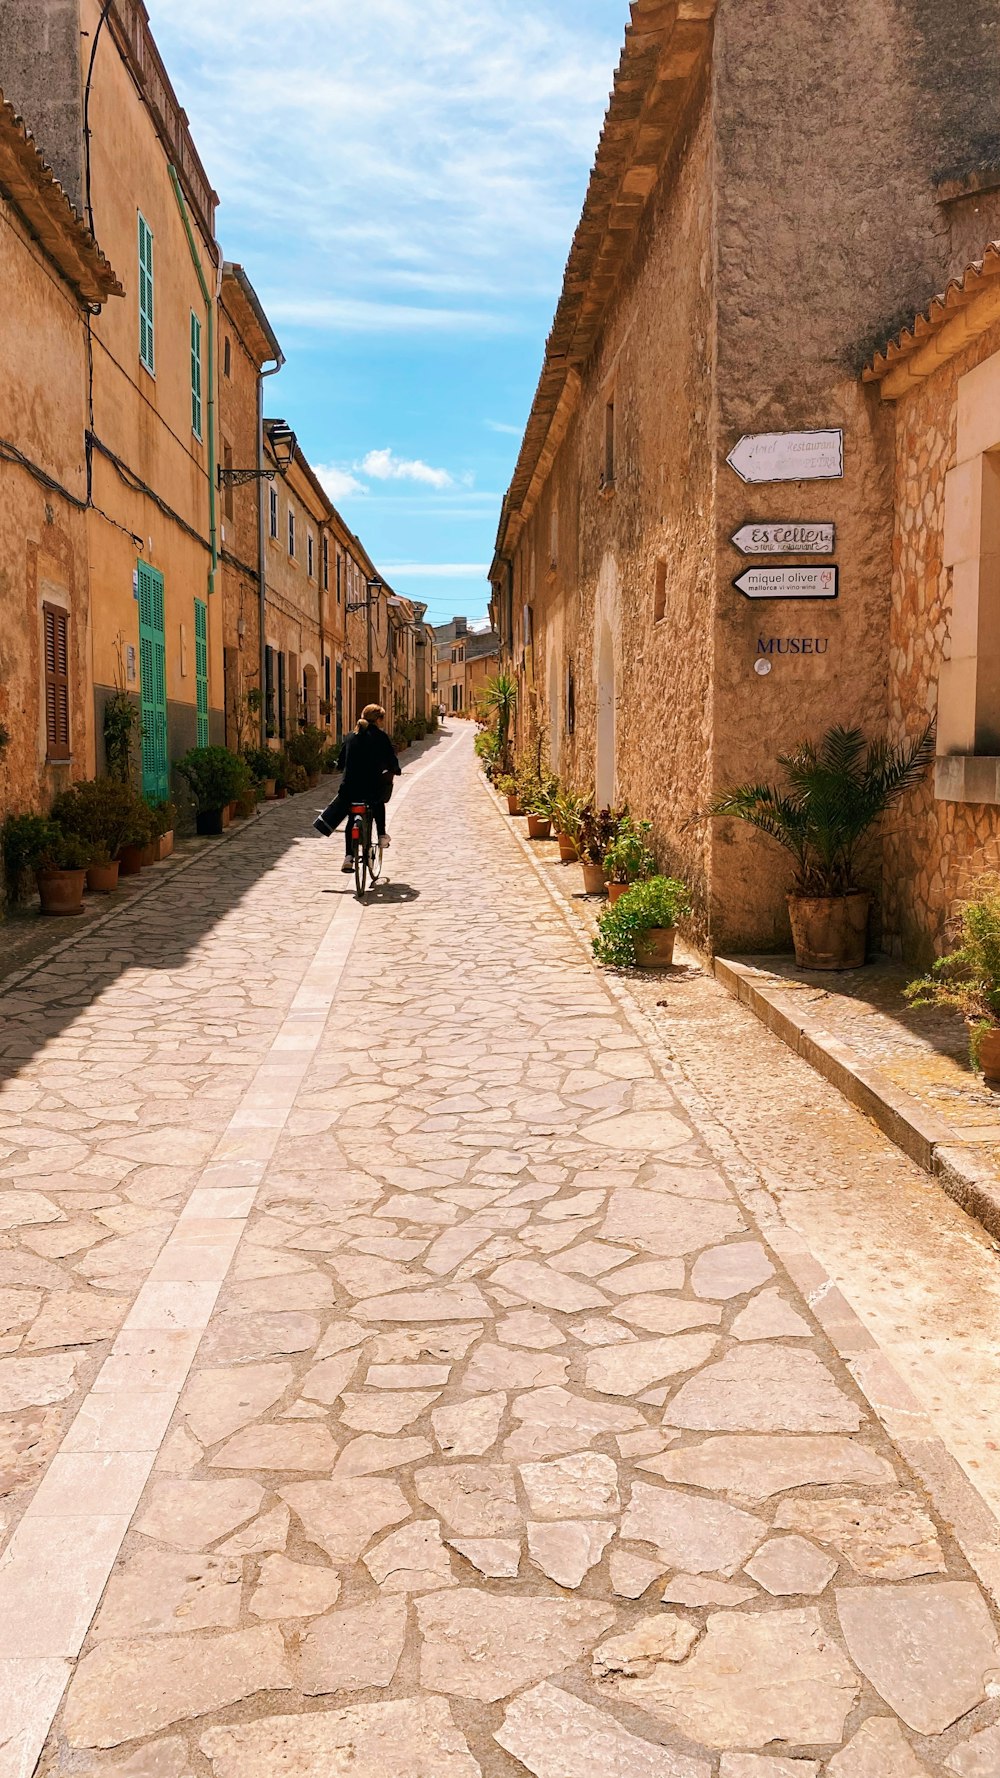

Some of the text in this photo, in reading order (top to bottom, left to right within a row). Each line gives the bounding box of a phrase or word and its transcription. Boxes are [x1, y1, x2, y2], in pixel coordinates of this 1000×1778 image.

[751, 528, 770, 543] Es
[748, 572, 818, 585] miquel oliver
[756, 638, 829, 654] MUSEU
